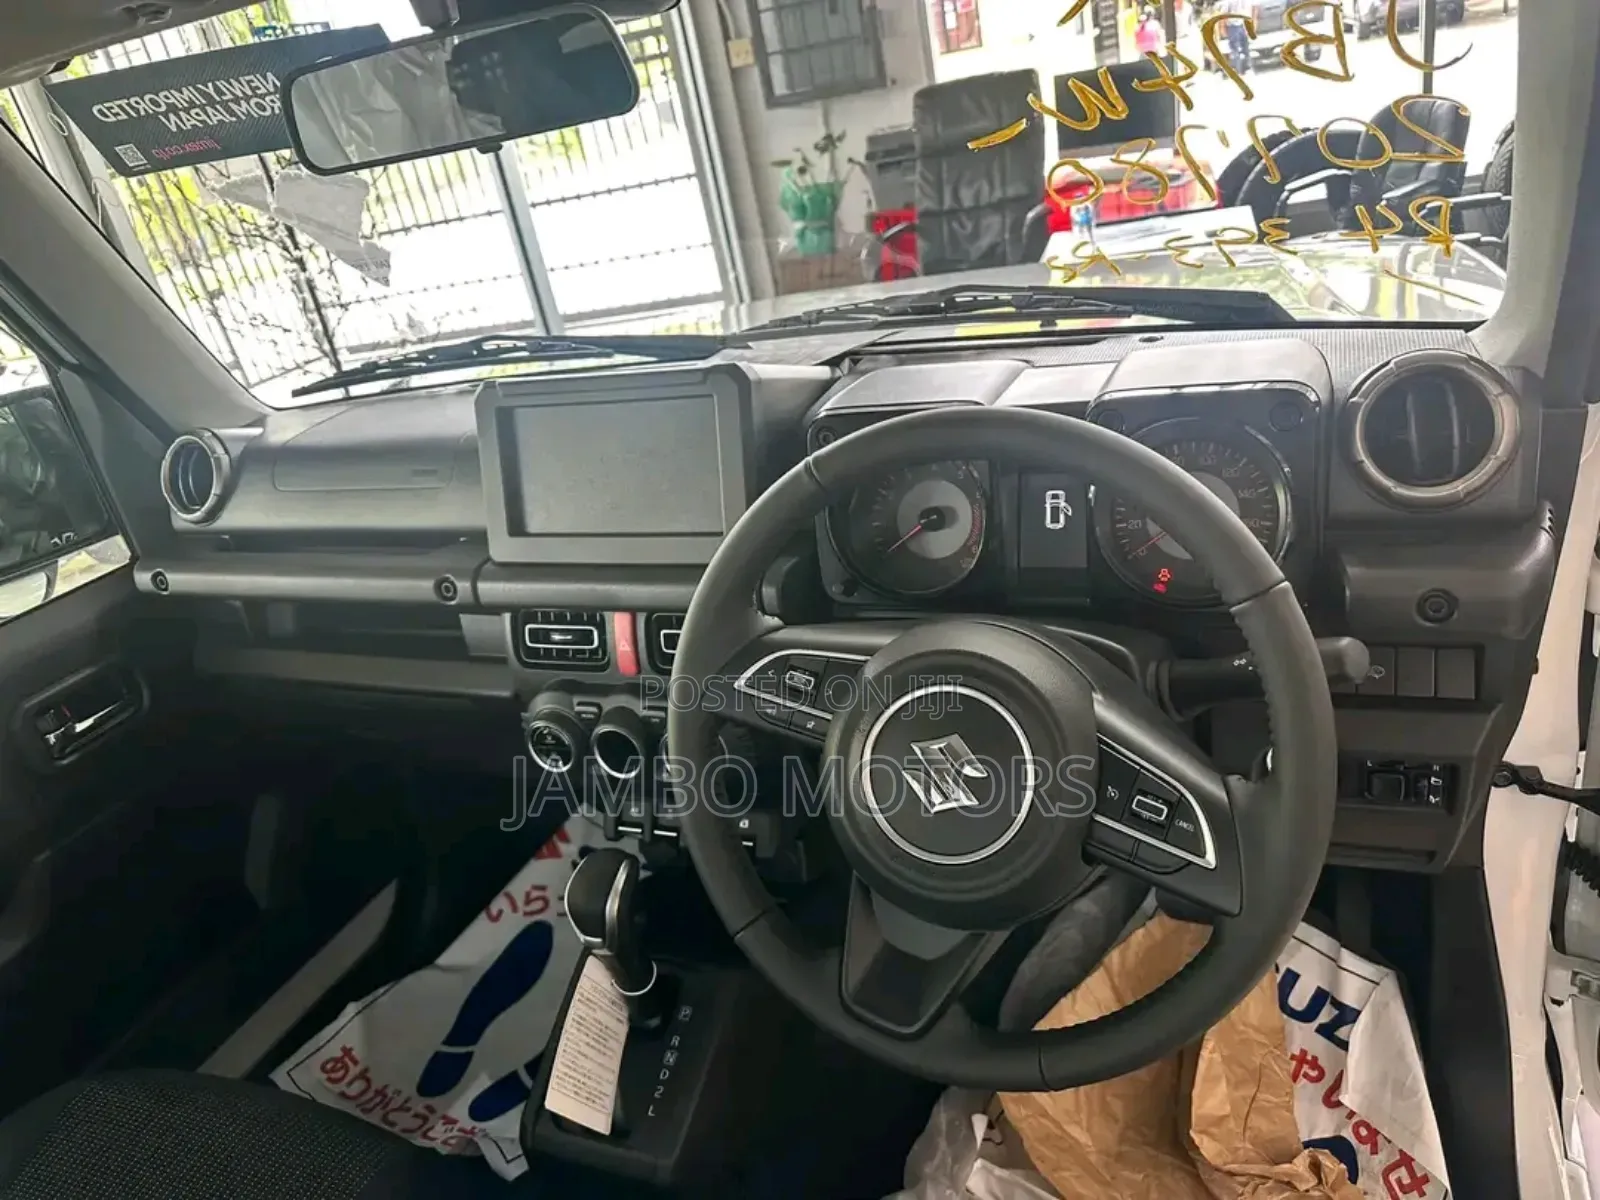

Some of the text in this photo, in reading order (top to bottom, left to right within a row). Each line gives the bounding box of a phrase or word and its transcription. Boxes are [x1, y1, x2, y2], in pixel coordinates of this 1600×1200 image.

[1127, 519, 1142, 530] 20
[1274, 962, 1363, 1052] UZ
[660, 1068, 670, 1080] D
[653, 1085, 664, 1098] 2
[647, 1104, 656, 1117] L
